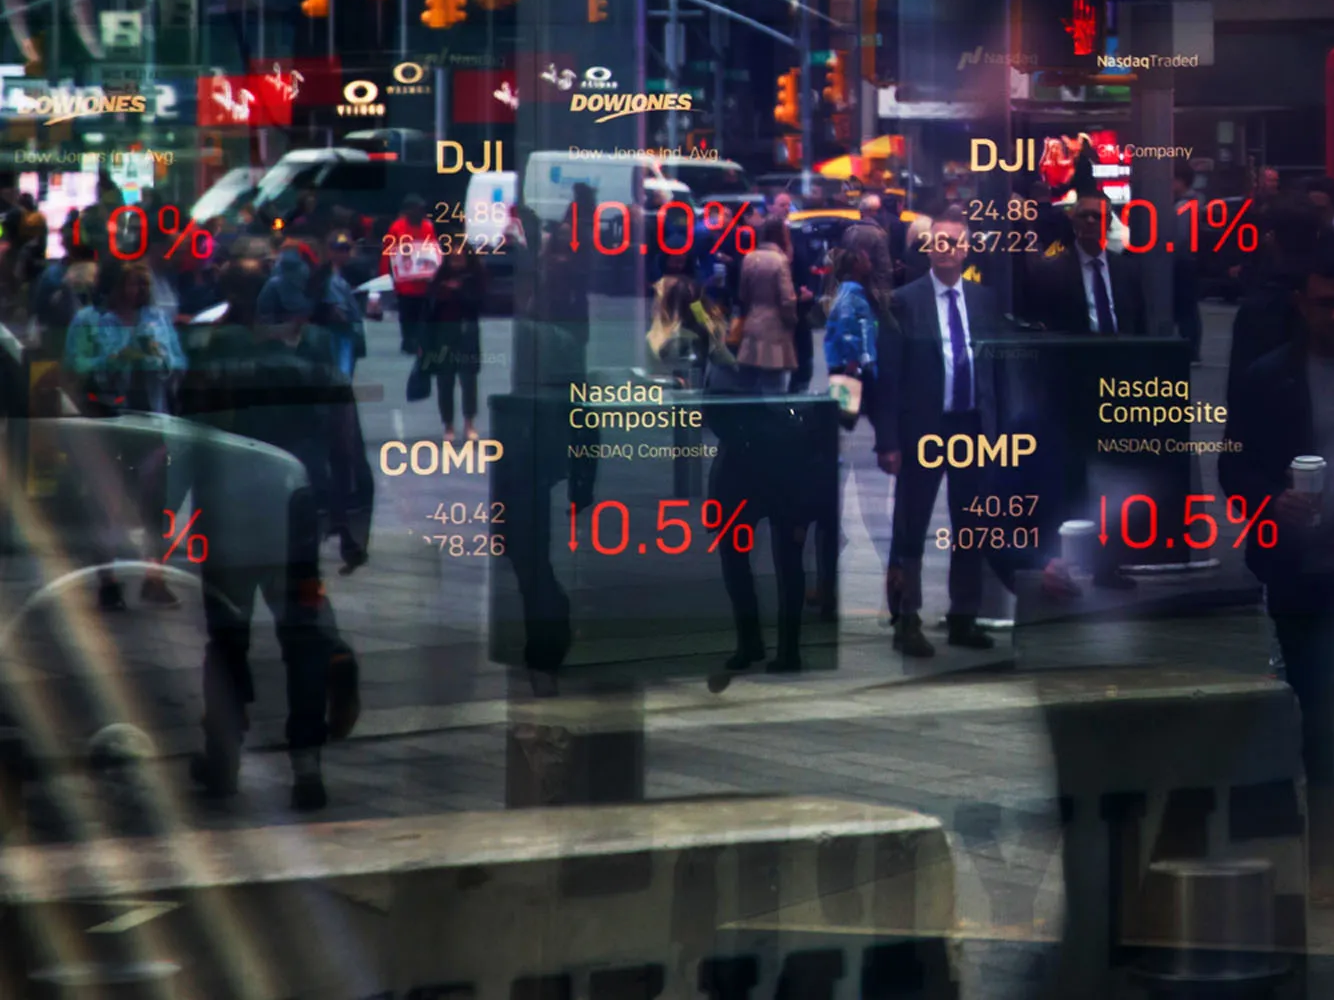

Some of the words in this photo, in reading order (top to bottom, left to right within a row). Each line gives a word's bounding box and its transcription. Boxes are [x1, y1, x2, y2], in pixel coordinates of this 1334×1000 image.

[569, 92, 694, 123] DOWJONES
[436, 139, 504, 175] DJI
[970, 136, 1035, 172] DJI
[1124, 144, 1194, 163] Company
[426, 201, 507, 225] -24.86
[961, 200, 1039, 222] -24.86
[592, 199, 758, 257] 0.0%
[1124, 198, 1260, 255] 0.1%
[917, 231, 1039, 256] 26,437.22
[569, 380, 664, 407] Nasdaq
[1098, 376, 1190, 402] Nasdaq
[569, 407, 703, 436] Composite
[1098, 402, 1229, 428] Composite
[379, 439, 505, 477] COMP
[567, 443, 634, 462] NASDAQ
[638, 442, 719, 462] Composite
[916, 433, 1038, 470] COMP
[1096, 437, 1161, 456] NASDAQ
[1165, 437, 1244, 458] Composite
[425, 501, 507, 525] -40.42
[961, 495, 1040, 519] -40.67
[591, 497, 756, 557] 0.5%
[1120, 494, 1280, 551] 0.5%
[934, 526, 1040, 553] 8,078.01
